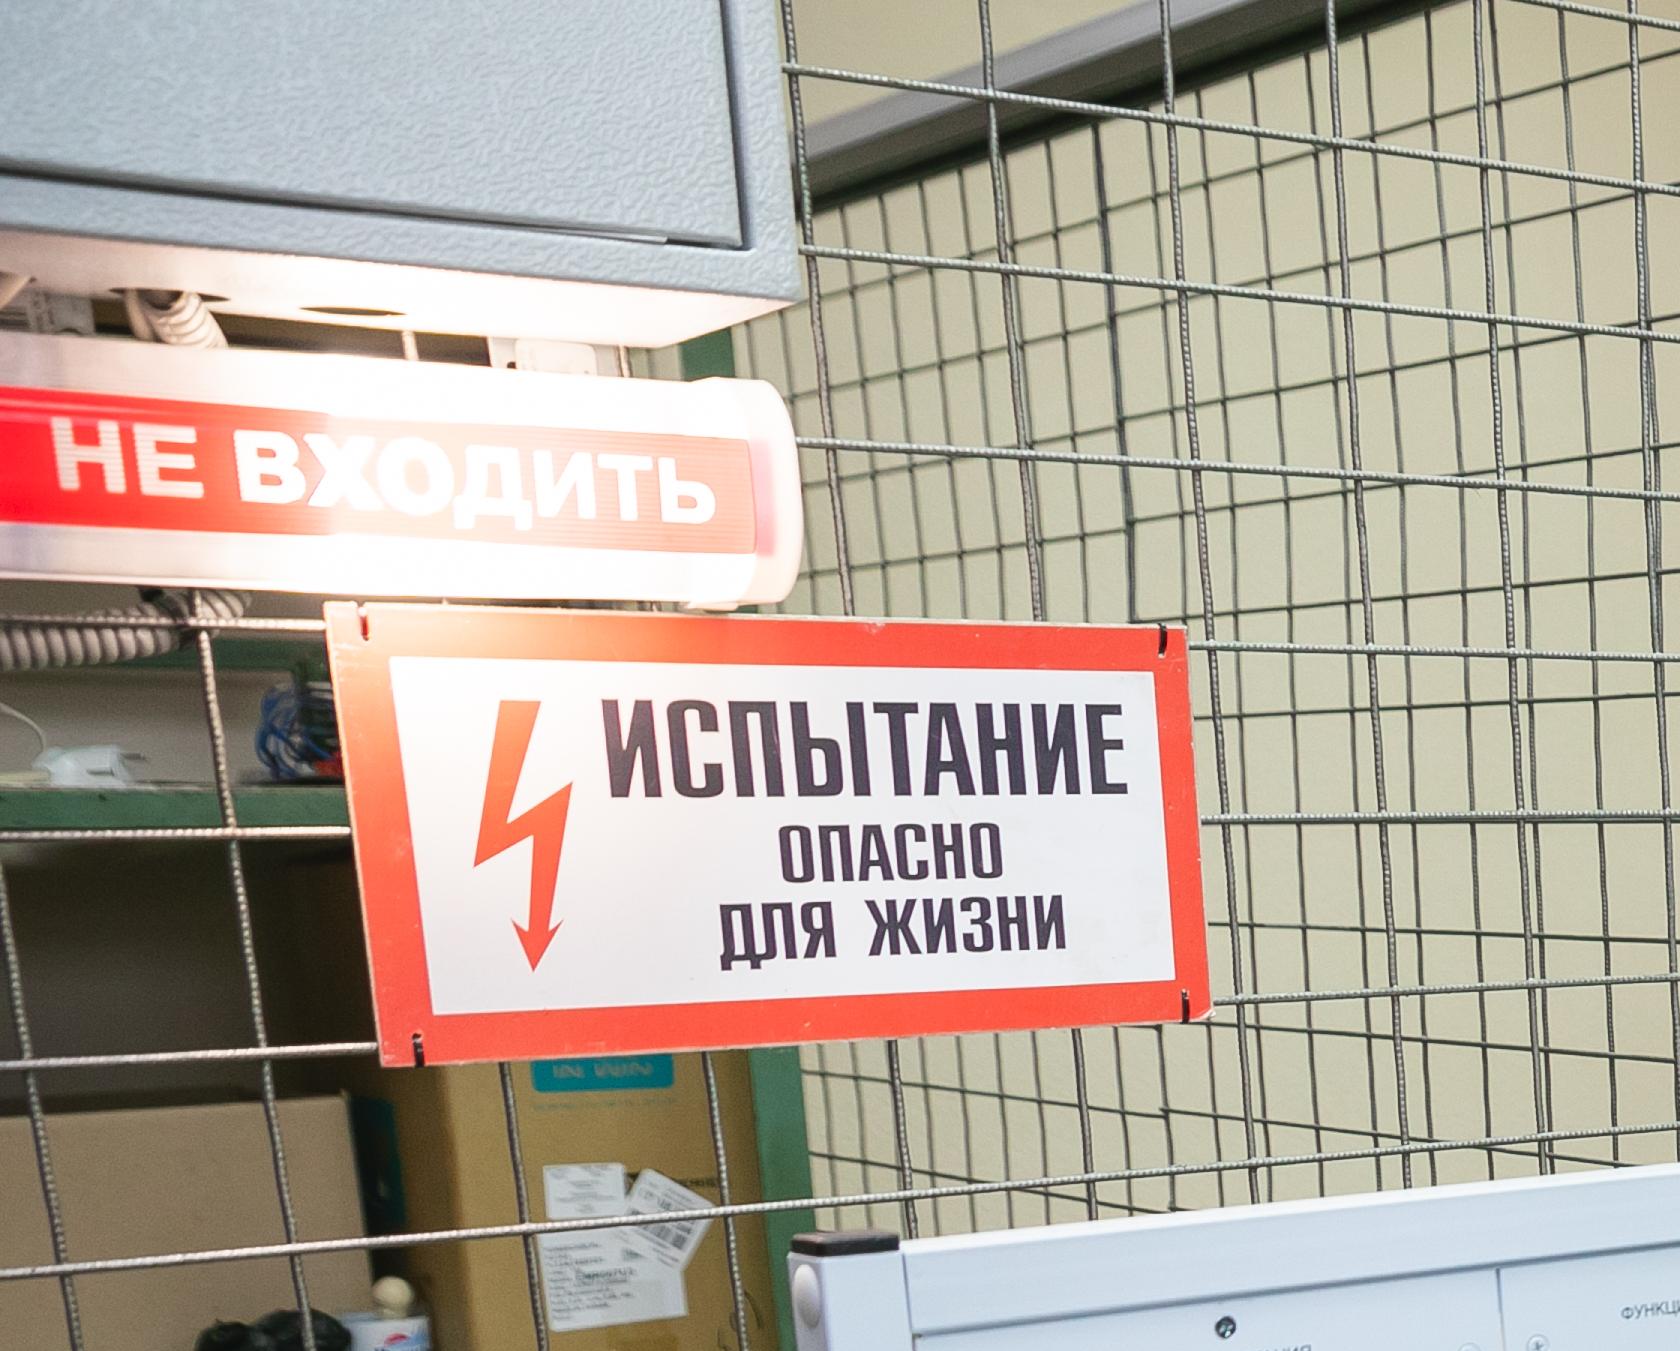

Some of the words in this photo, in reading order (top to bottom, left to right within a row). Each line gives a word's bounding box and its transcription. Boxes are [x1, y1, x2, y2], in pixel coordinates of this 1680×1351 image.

[49, 415, 203, 499] НЕ
[236, 428, 718, 531] ВХОДИТЬ
[600, 698, 1129, 799] ИСПЫТАНИЕ
[779, 822, 1001, 883] ОПАСНО
[719, 897, 836, 972] ДЛЯ
[868, 894, 1067, 956] ЖИЗНИ
